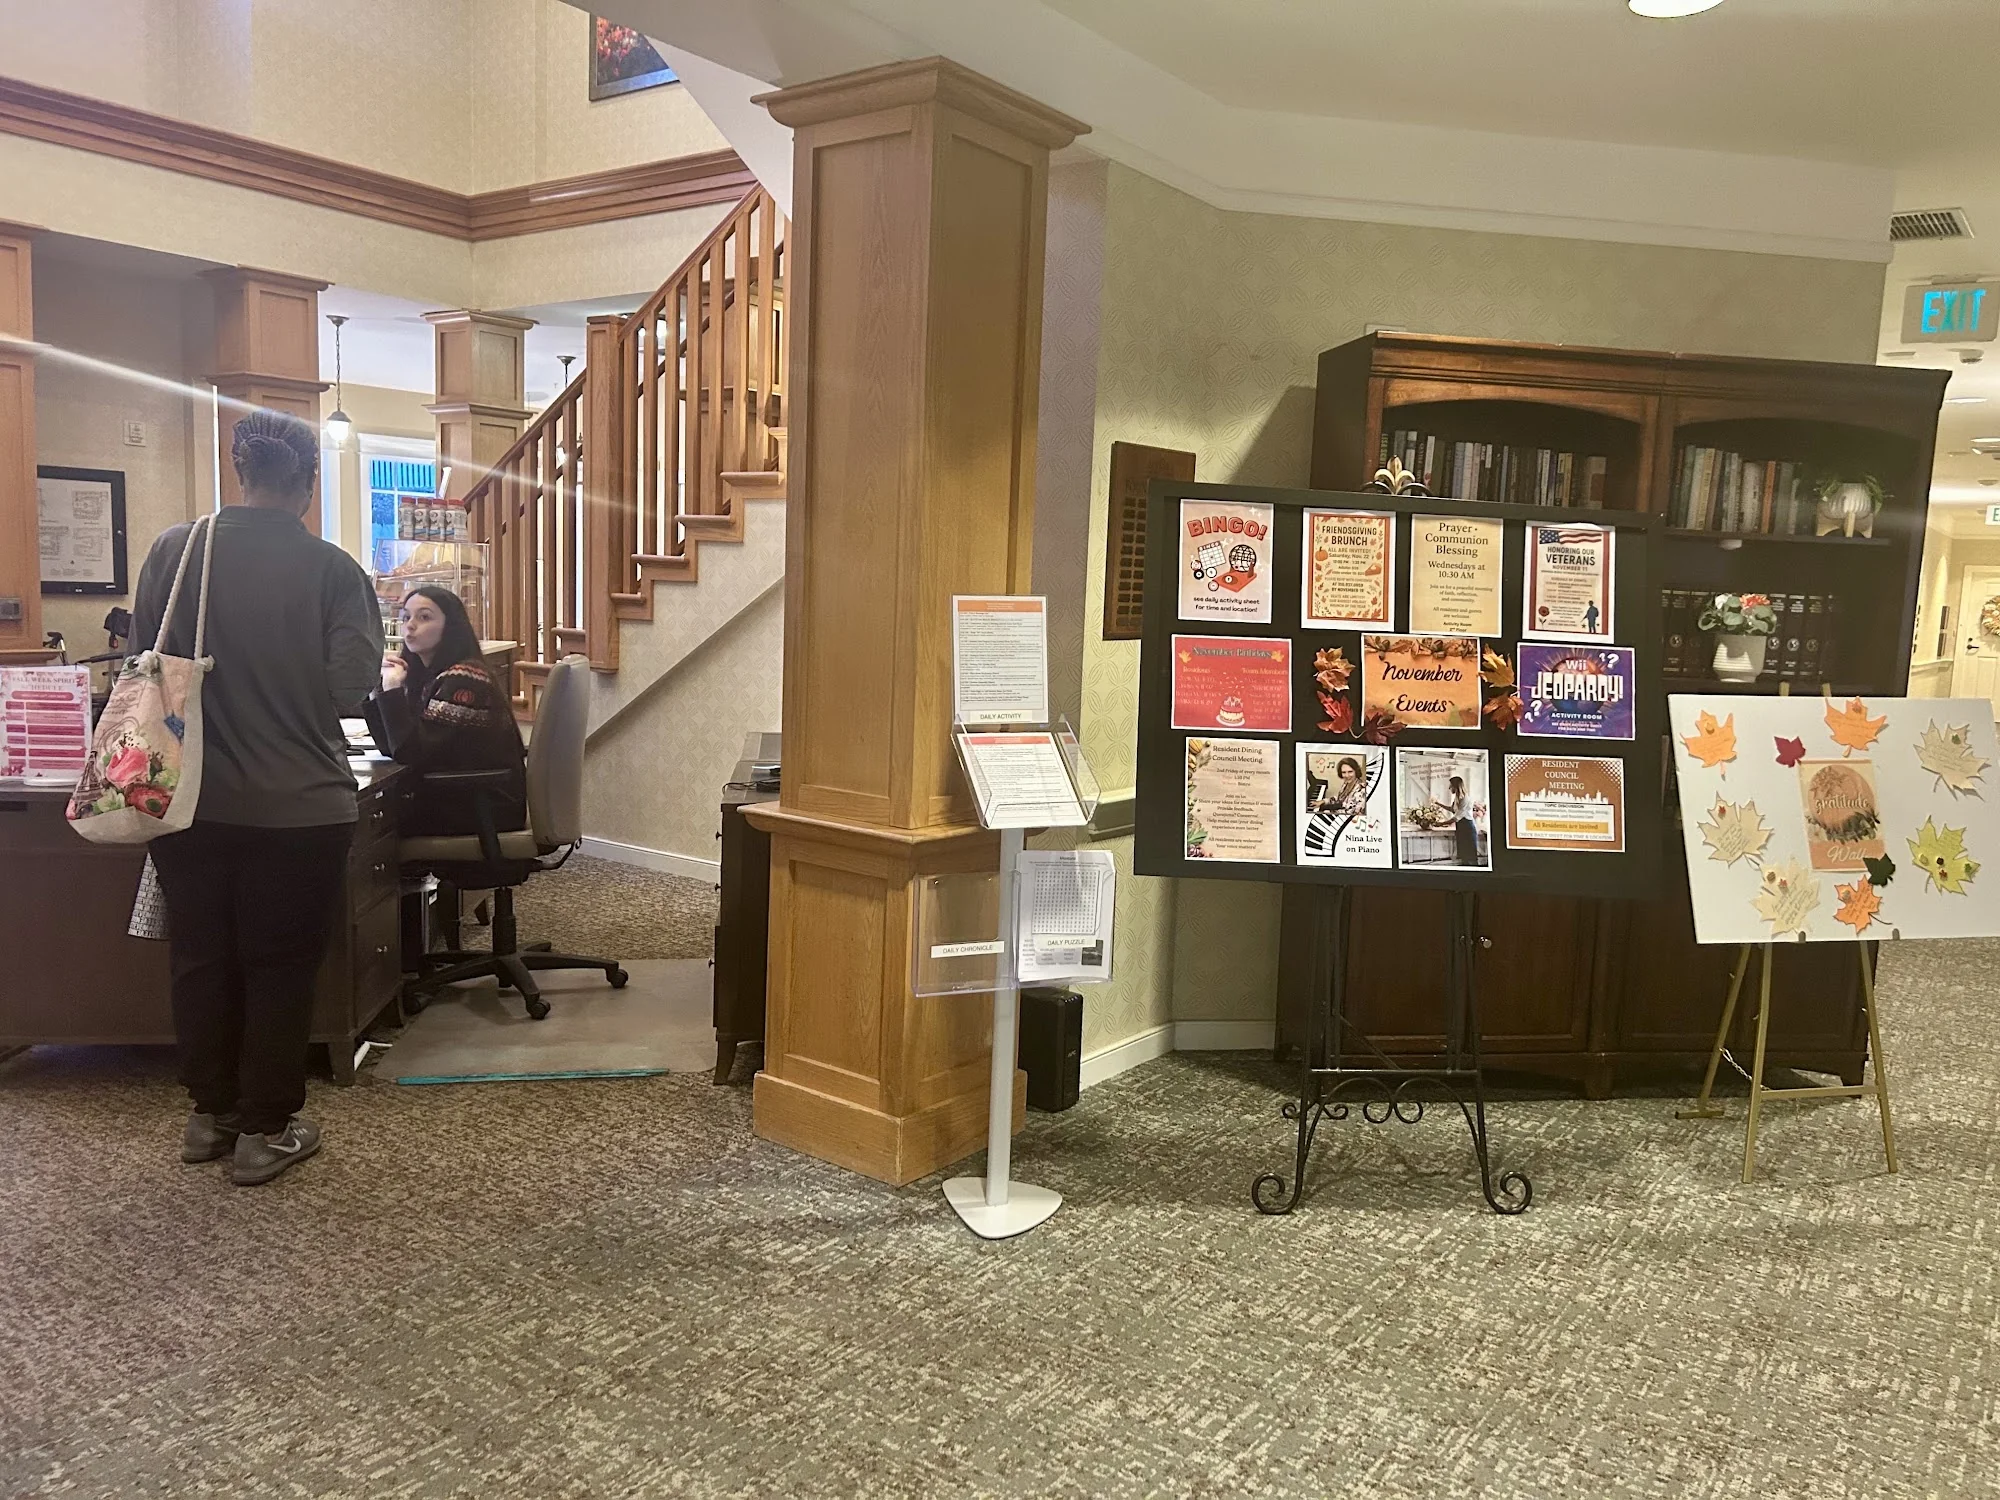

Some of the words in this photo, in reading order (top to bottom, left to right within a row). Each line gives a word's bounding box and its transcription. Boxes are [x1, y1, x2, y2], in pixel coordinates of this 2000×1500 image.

[1921, 288, 1986, 334] EXIT
[1187, 516, 1268, 541] BINGO!
[1322, 526, 1377, 535] FRIENDSGIVING
[1439, 522, 1472, 534] Prayer
[1332, 536, 1367, 545] BRUNCH
[1425, 533, 1488, 545] Communion
[1436, 545, 1478, 558] Blessing
[1428, 561, 1476, 570] Wednesdays
[1546, 554, 1595, 566] VETERANS
[1438, 570, 1458, 578] 10:30
[1193, 647, 1234, 656] November
[1237, 648, 1272, 658] Birthdays
[1565, 660, 1587, 670] Wii
[1382, 661, 1462, 682] November
[1531, 671, 1623, 702] JEOPARDY!
[1395, 694, 1447, 712] Events
[1213, 745, 1240, 753] Resident
[1238, 756, 1263, 764] Meeting
[1542, 760, 1579, 768] RESIDENT
[1544, 771, 1579, 779] COUNCIL
[1549, 782, 1585, 790] MEETING
[1816, 793, 1869, 815] gratitude
[1345, 834, 1364, 842] Nina
[1827, 846, 1868, 863] Wall
